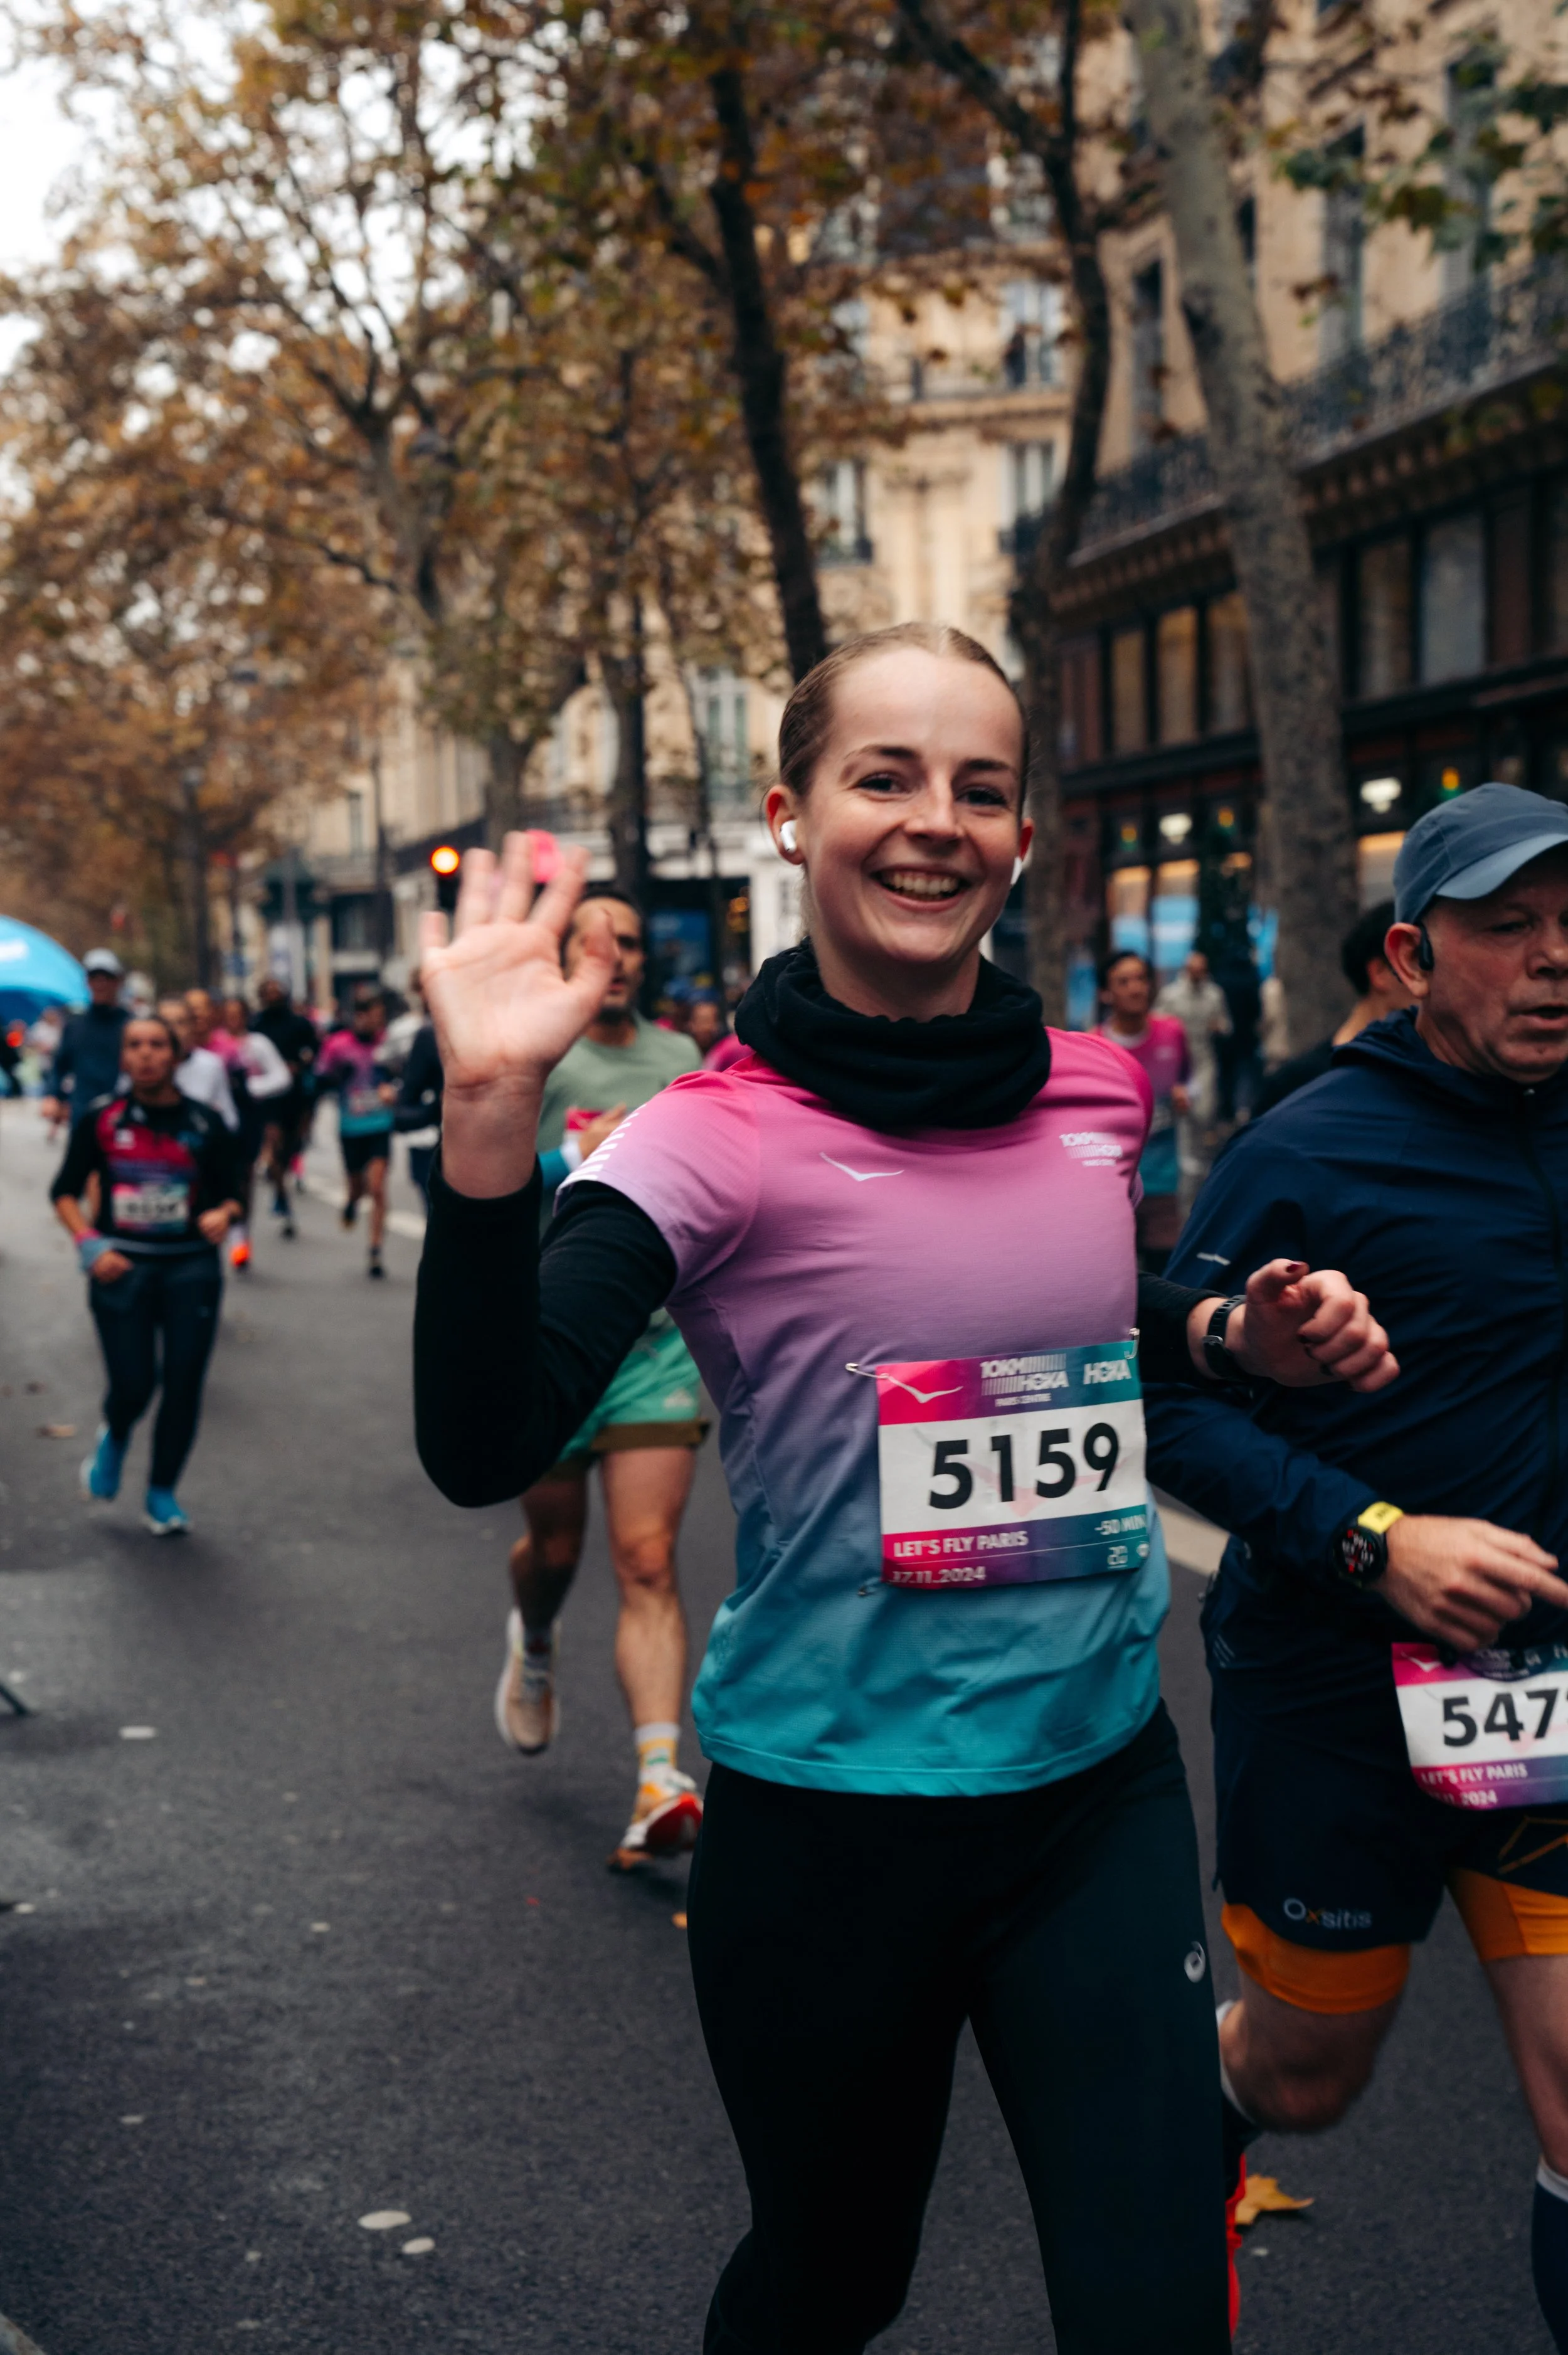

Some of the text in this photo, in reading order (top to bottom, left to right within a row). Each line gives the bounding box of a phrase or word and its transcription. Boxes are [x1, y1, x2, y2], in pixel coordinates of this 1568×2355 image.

[980, 1357, 1025, 1379] 10KM
[1021, 1370, 1069, 1391] HOKA
[1083, 1358, 1132, 1385] HOKA
[928, 1422, 1120, 1510] 5159
[893, 1530, 1029, 1558] LET'S FLY PARIS
[891, 1565, 987, 1584] 17.11.2024
[1443, 1688, 1568, 1747] 547
[1421, 1762, 1528, 1786] LET'S FLY PARIS
[1283, 1897, 1372, 1929] Oxsitis
